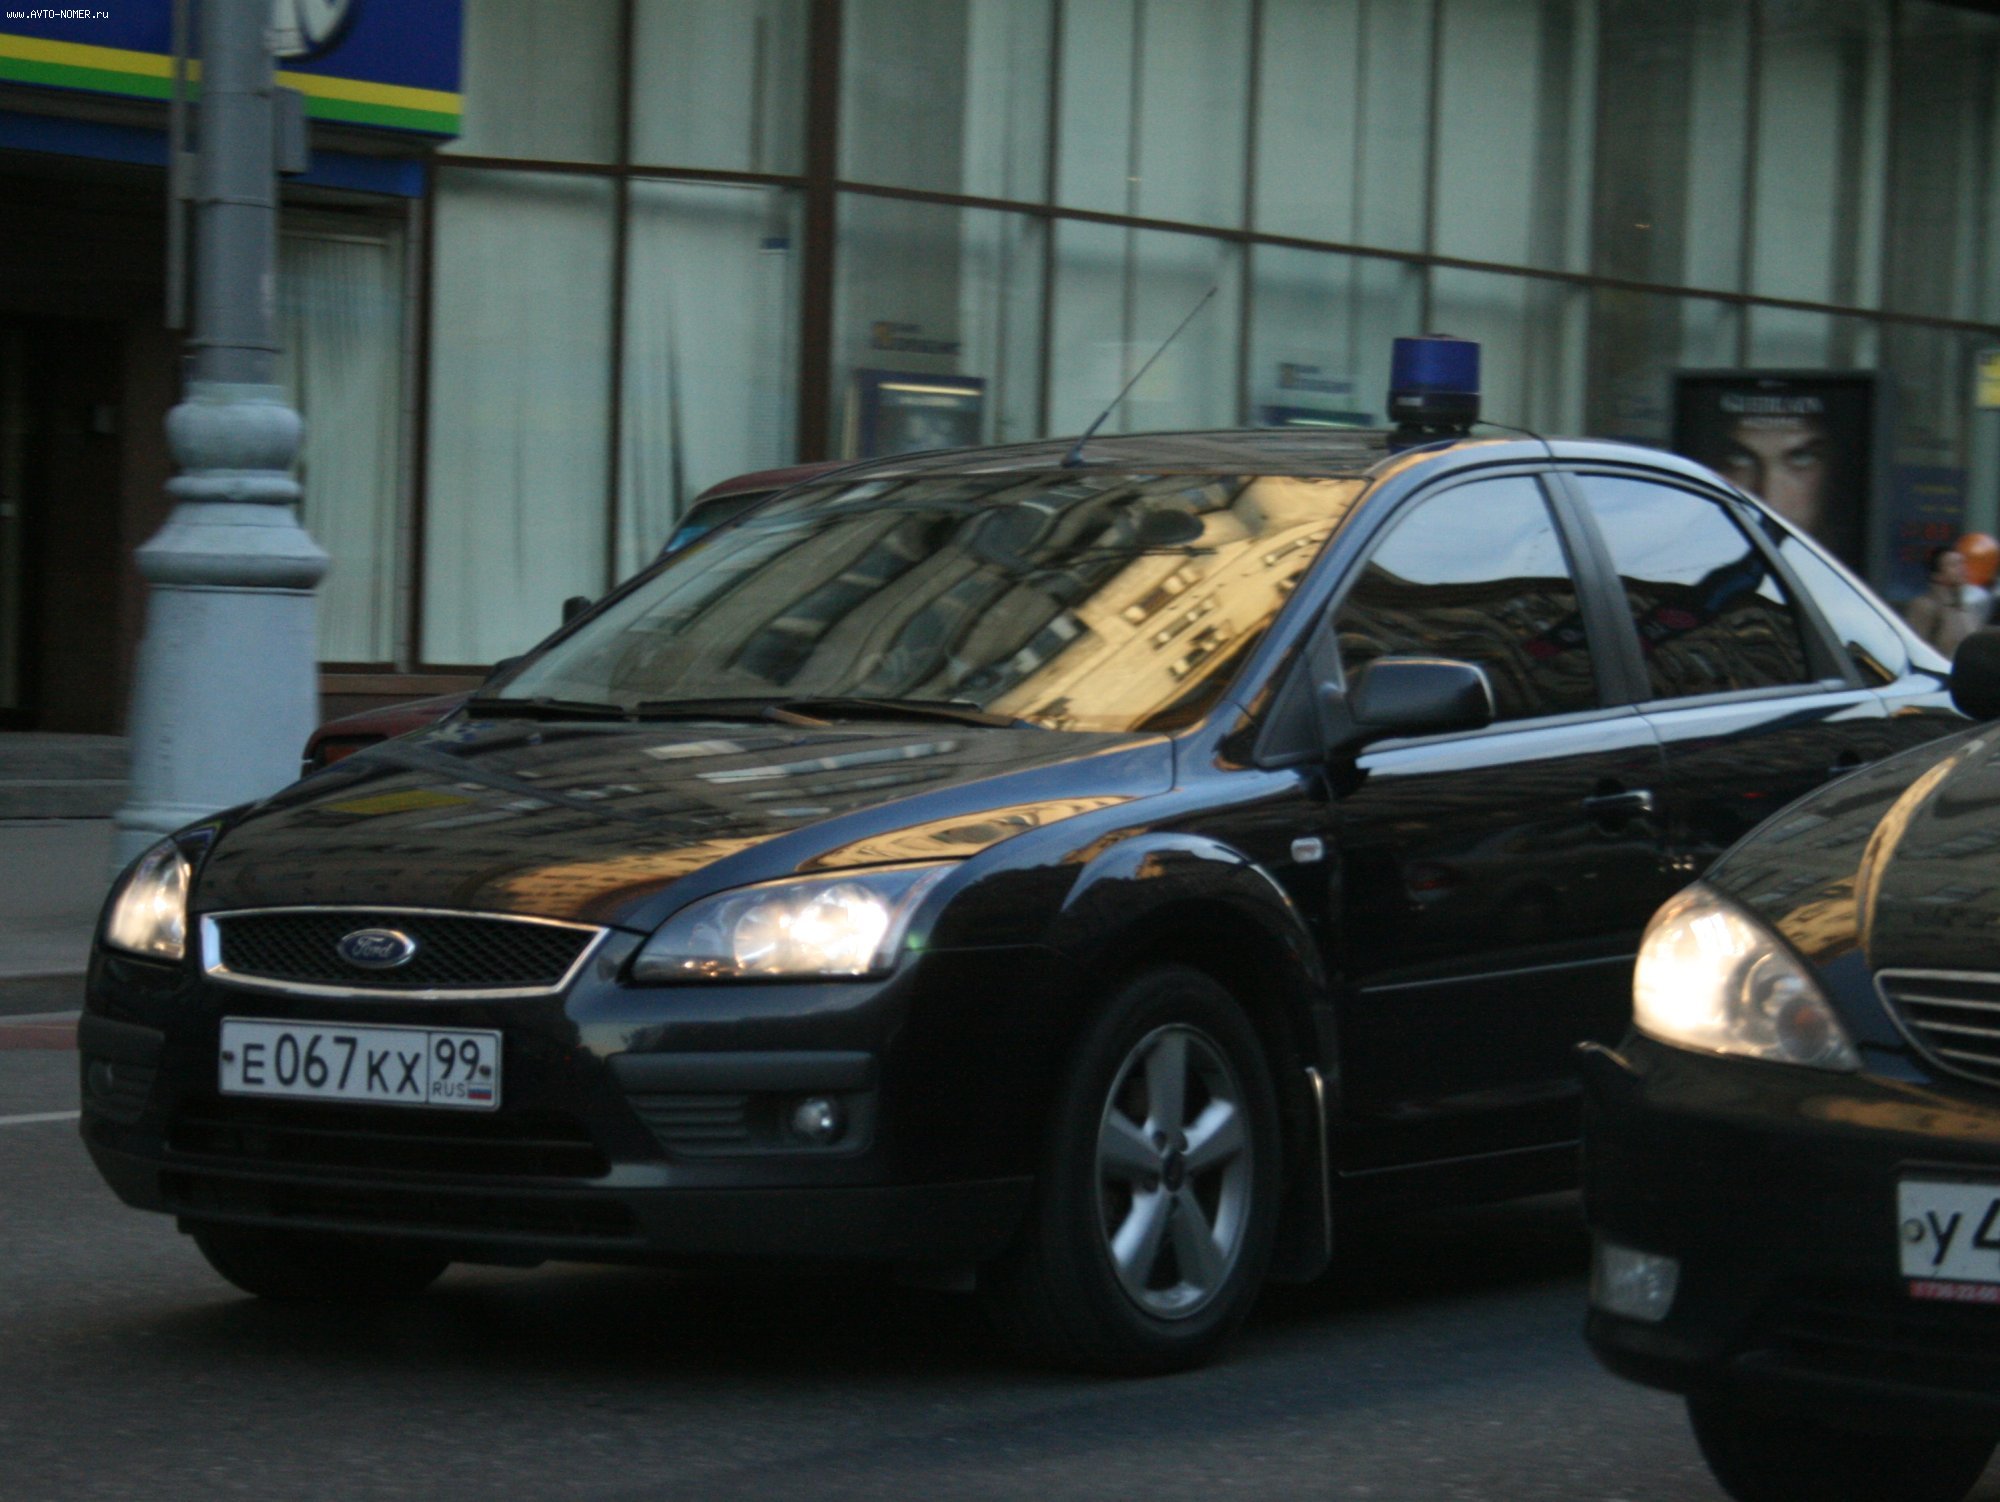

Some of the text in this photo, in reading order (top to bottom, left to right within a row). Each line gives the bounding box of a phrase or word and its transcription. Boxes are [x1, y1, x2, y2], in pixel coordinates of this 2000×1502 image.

[351, 935, 396, 958] Ford
[434, 1037, 481, 1081] 99
[432, 1081, 467, 1098] RUS
